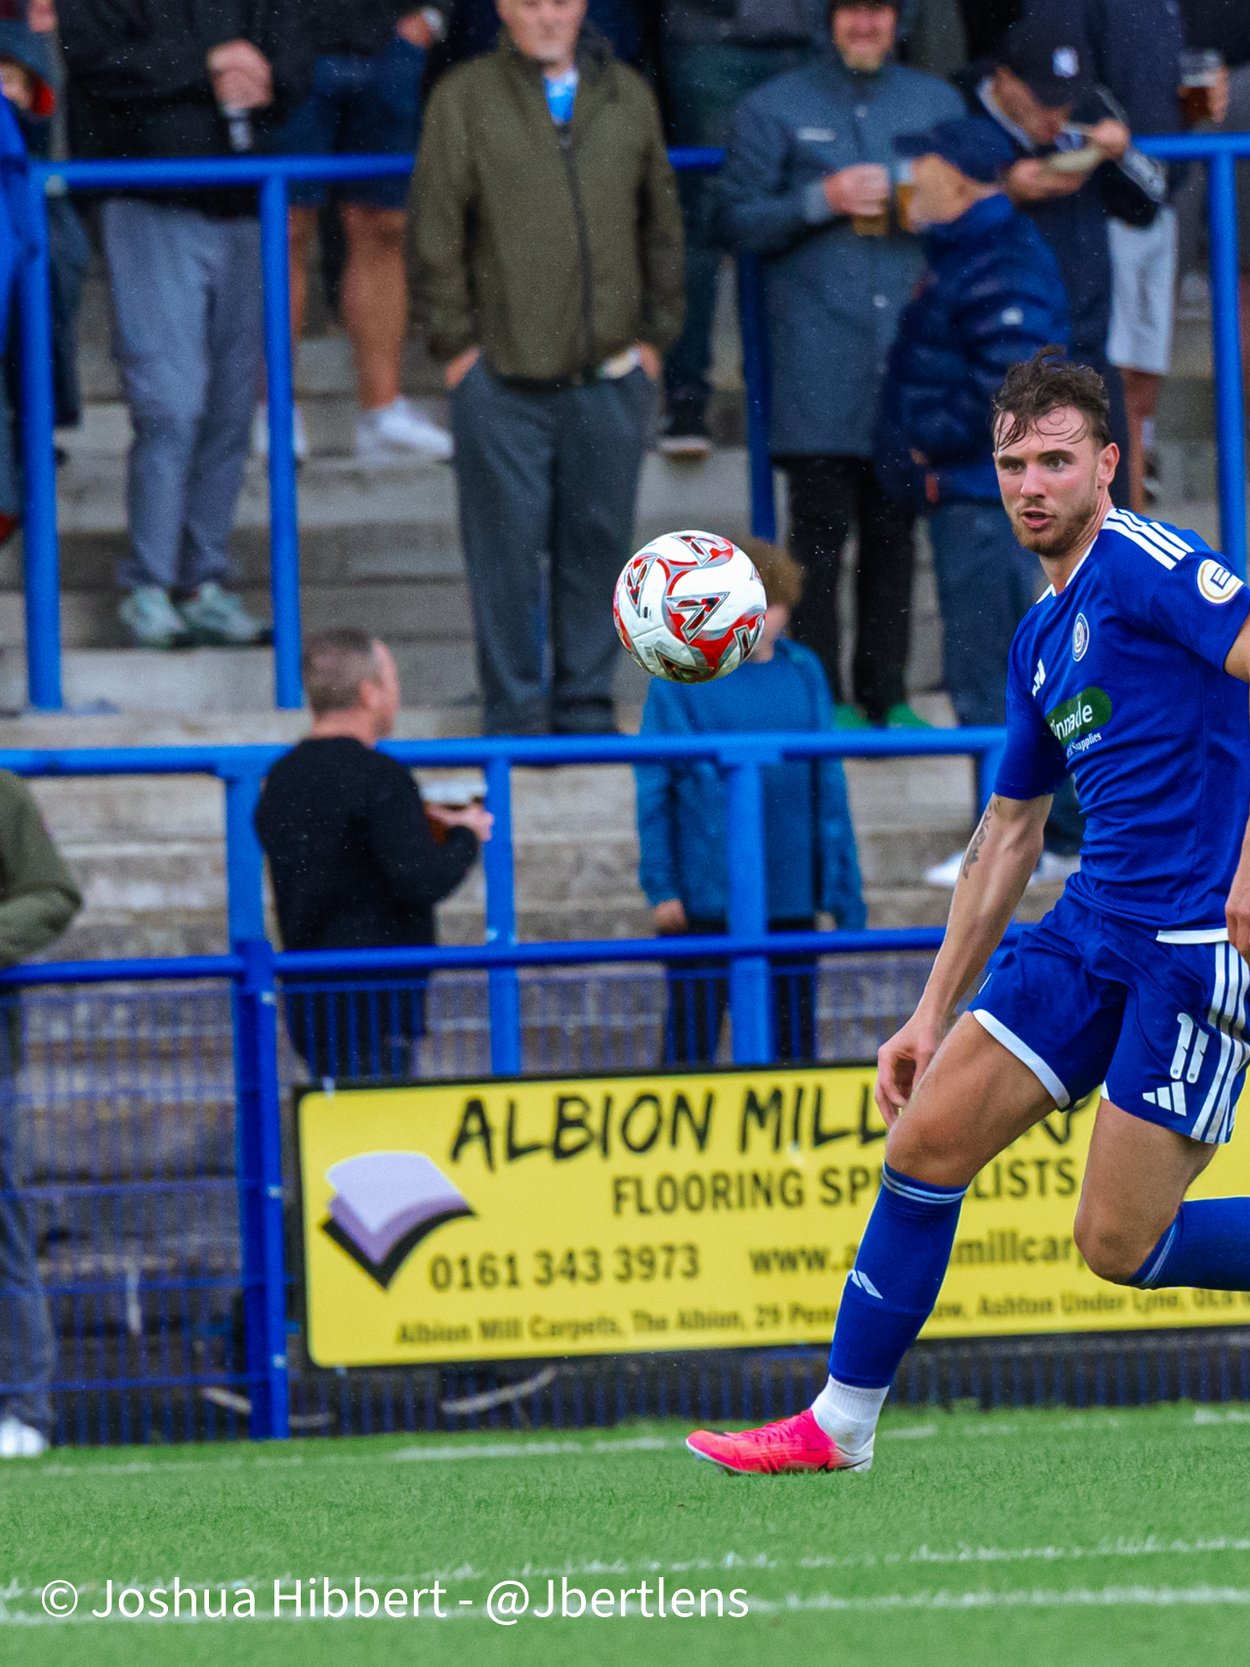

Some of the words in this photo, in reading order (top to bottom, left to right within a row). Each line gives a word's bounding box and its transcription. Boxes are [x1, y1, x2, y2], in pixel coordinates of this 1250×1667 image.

[1169, 1012, 1210, 1084] 11
[450, 1091, 713, 1173] ALBION
[740, 1084, 886, 1153] MILL
[613, 1170, 803, 1216] FLOORING
[819, 1157, 1078, 1209] SPLISTS
[429, 1251, 520, 1293] 0161
[534, 1247, 602, 1287] 343
[614, 1244, 699, 1284] 3973
